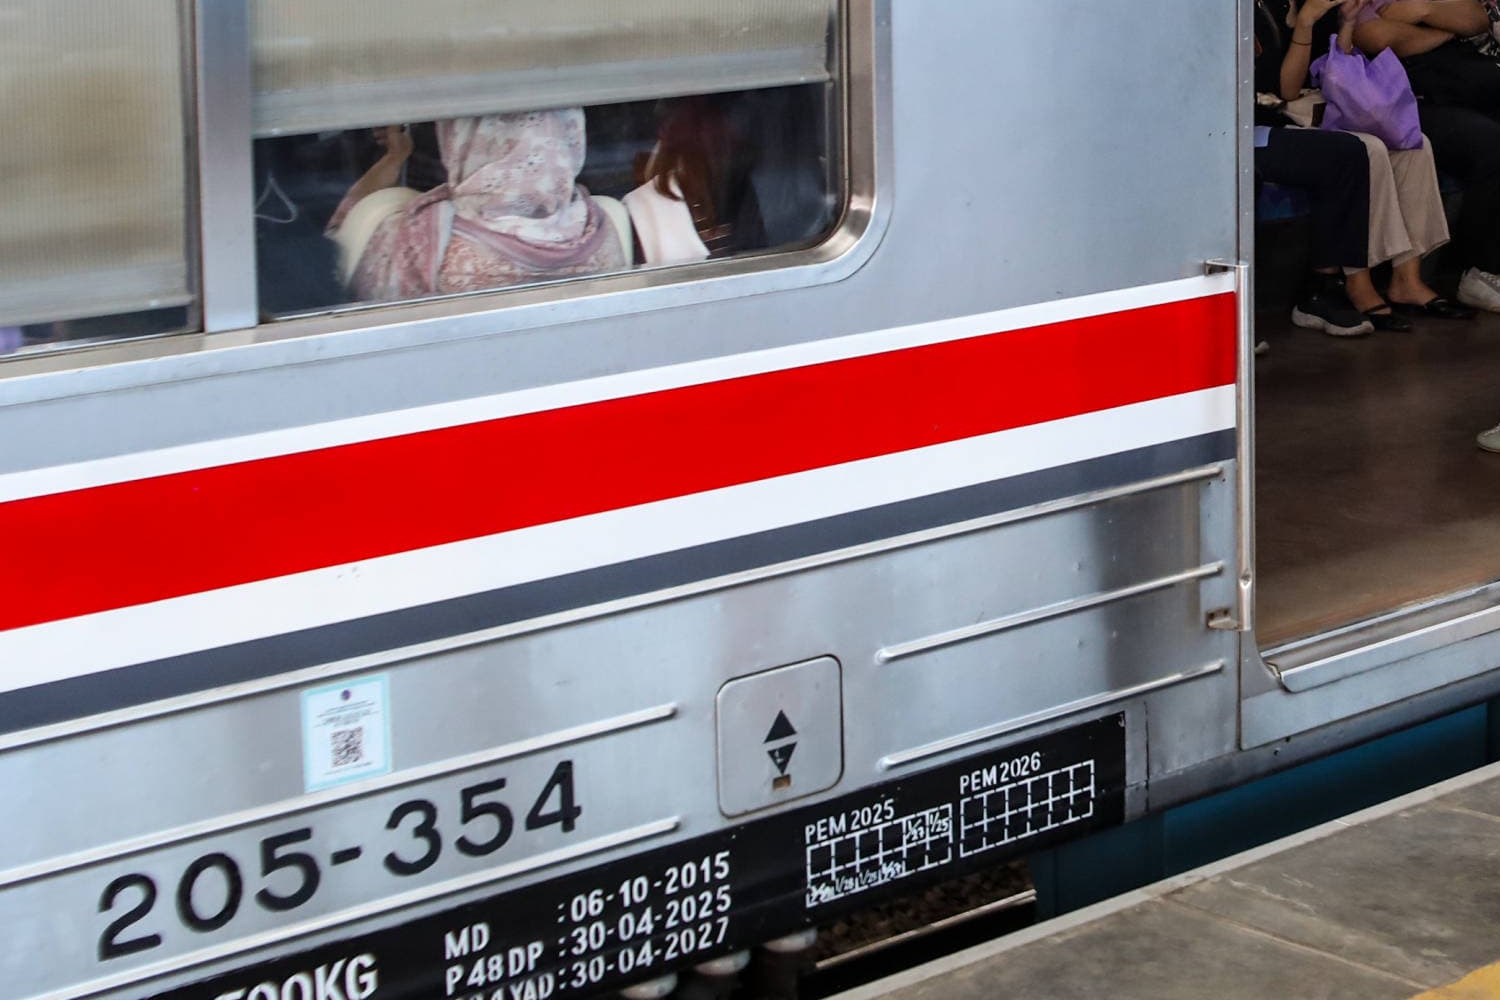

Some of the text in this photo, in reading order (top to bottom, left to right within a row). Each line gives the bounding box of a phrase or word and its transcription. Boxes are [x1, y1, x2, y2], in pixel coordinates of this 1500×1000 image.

[960, 751, 1042, 794] PEM 2026
[805, 799, 895, 844] PEM 2025
[97, 760, 582, 962] 205-354
[444, 922, 490, 960] MD
[508, 940, 545, 977] DP
